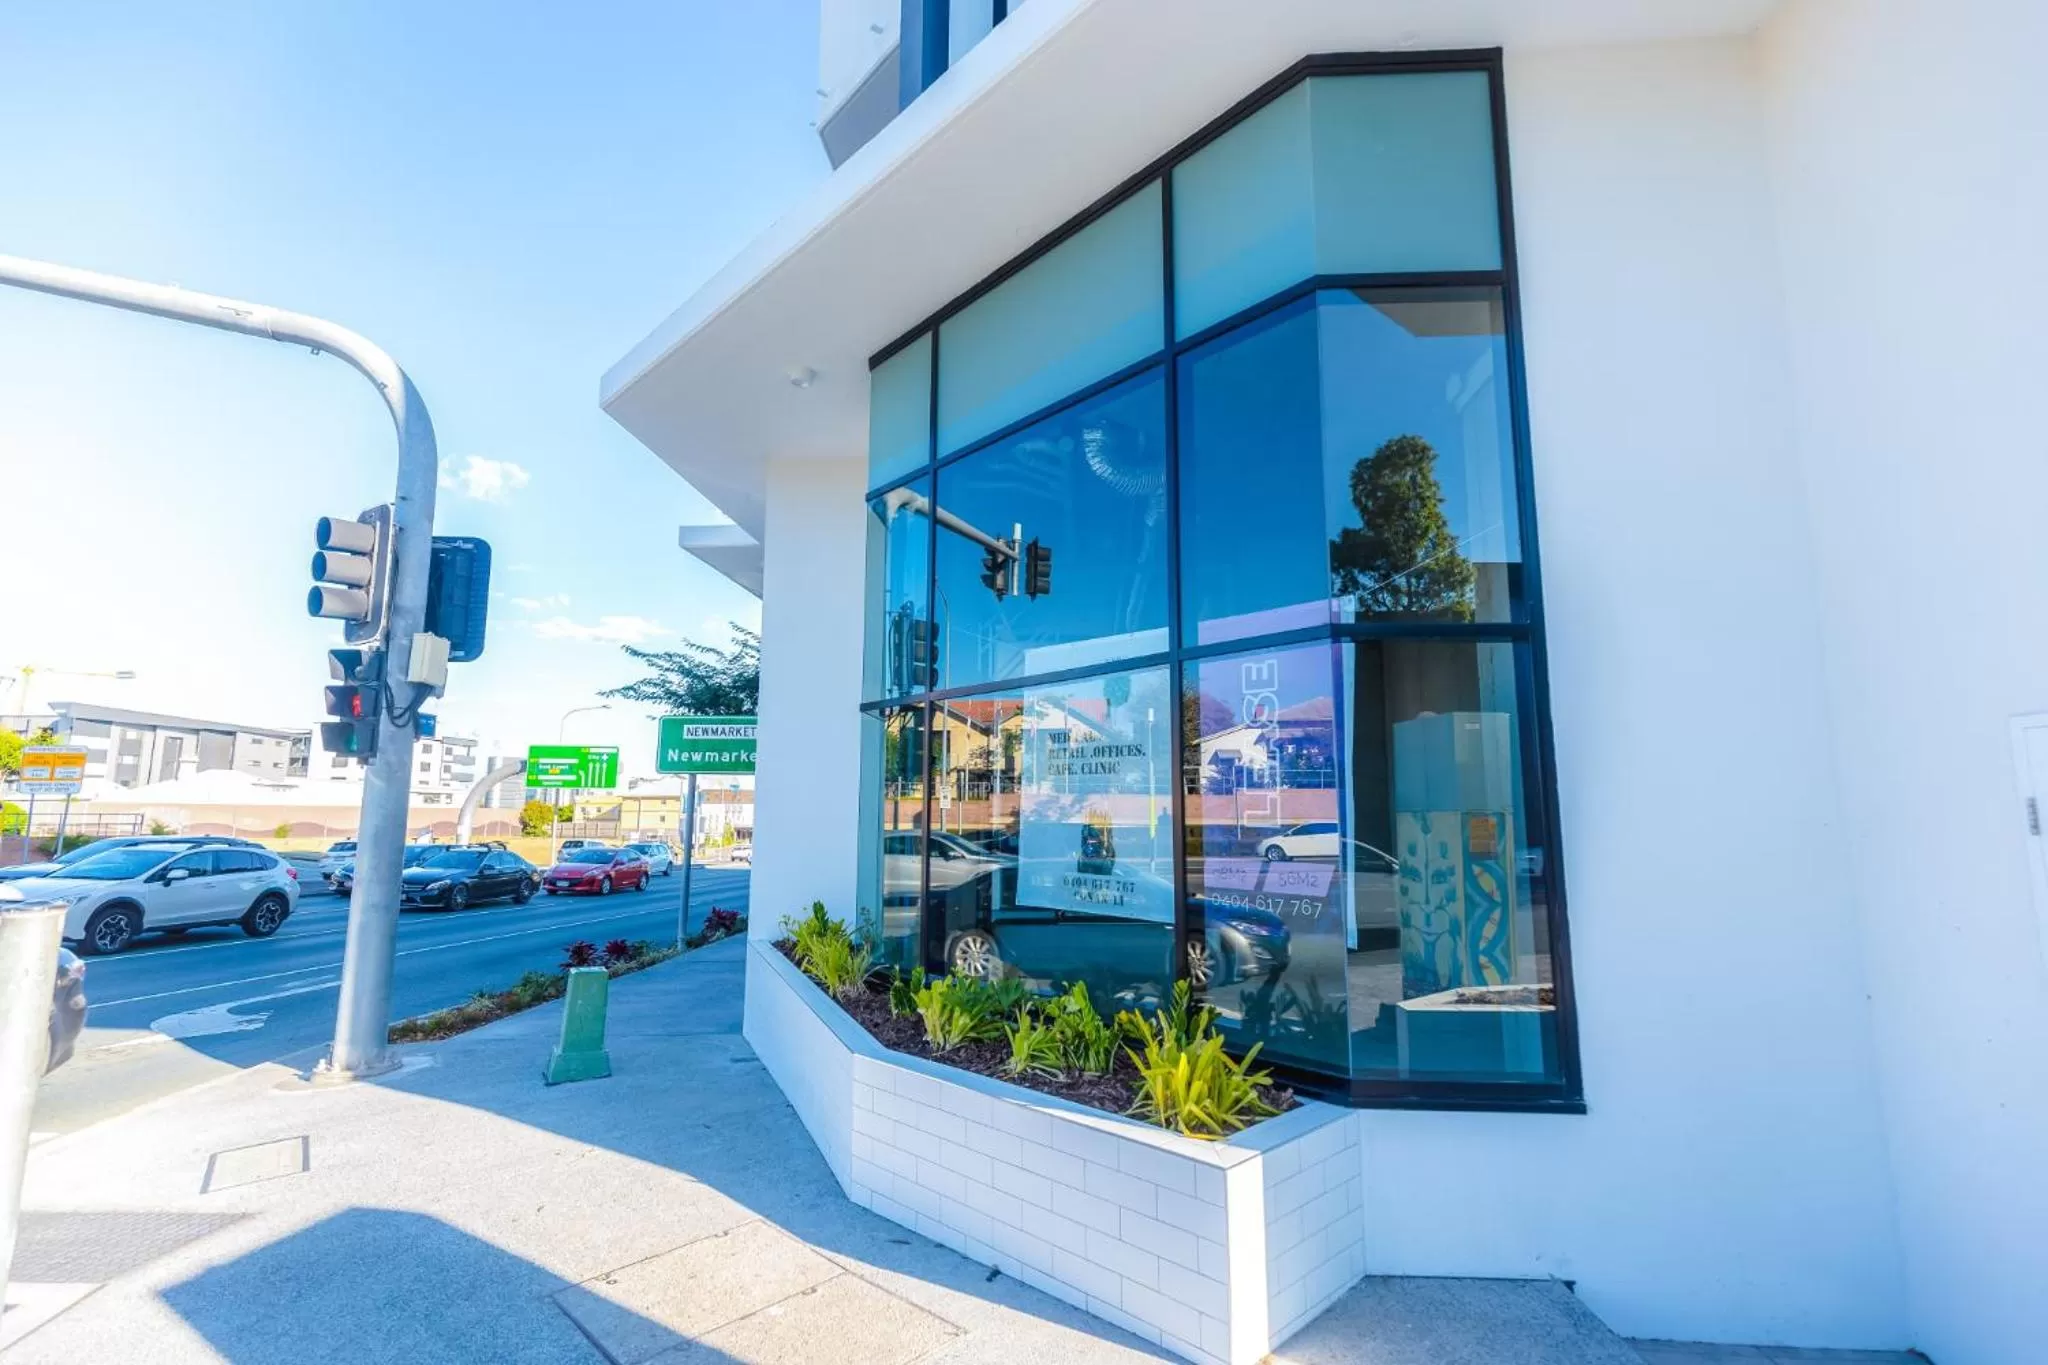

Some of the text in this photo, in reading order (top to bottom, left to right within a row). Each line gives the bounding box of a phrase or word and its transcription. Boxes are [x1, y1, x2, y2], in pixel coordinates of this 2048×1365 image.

[686, 726, 757, 737] NEWMARKET
[1081, 760, 1120, 775] CLINIC
[1211, 892, 1322, 919] 0404 617 767
